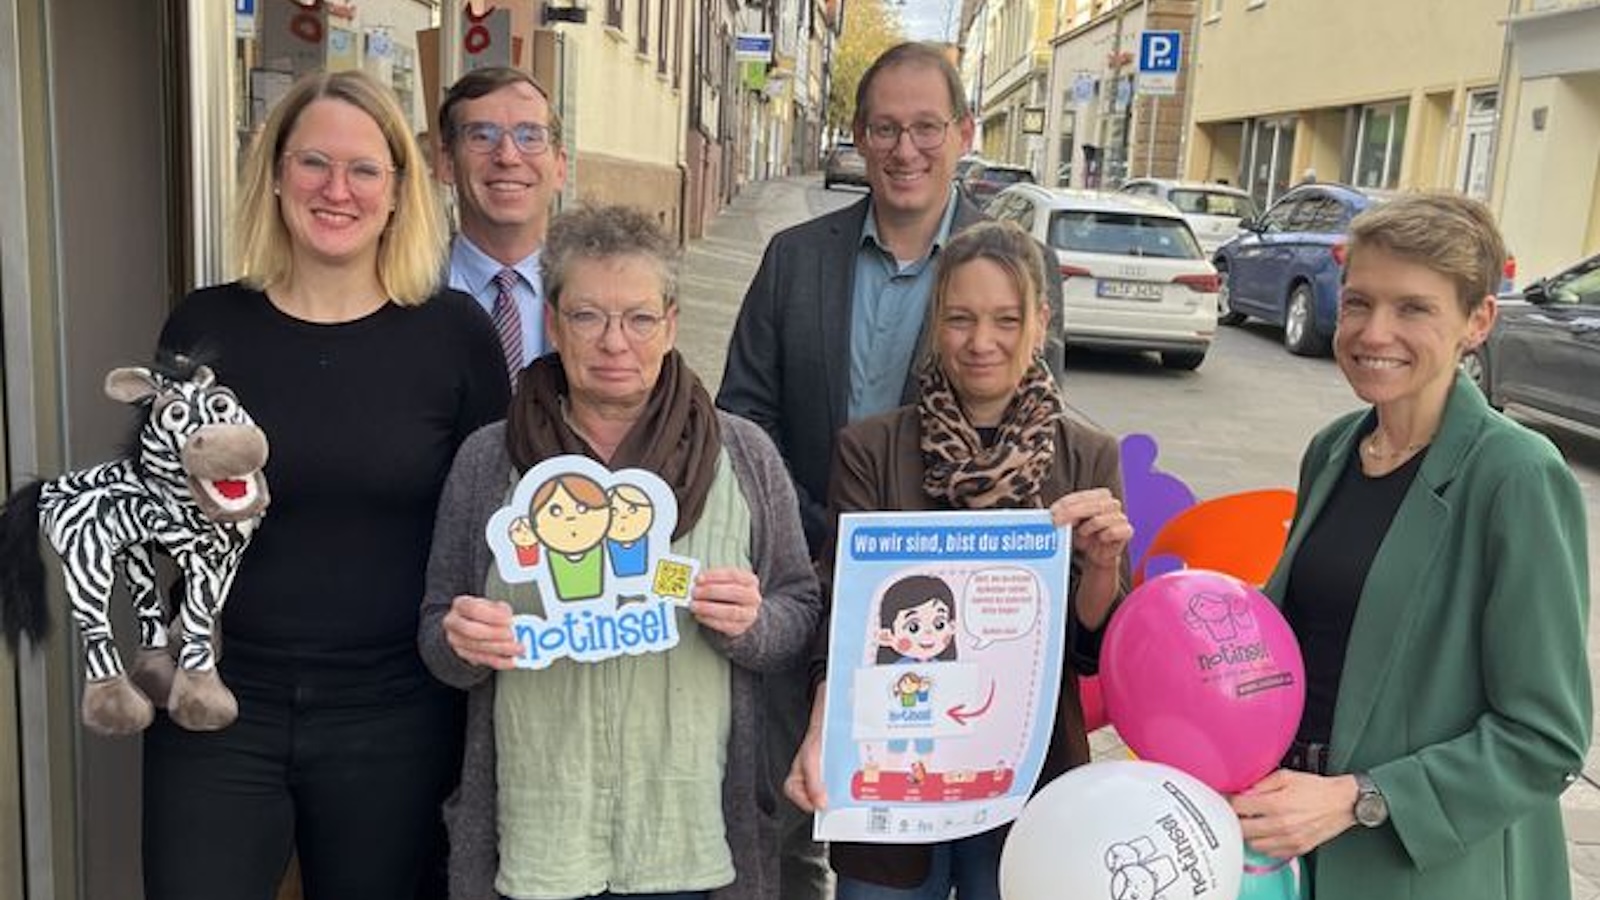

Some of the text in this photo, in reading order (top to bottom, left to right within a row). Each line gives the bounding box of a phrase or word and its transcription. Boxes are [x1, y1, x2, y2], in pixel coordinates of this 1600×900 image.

[1148, 36, 1171, 69] P
[854, 531, 1056, 554] Wo wir sind, bist du sicher!
[516, 601, 669, 660] notinsel
[1156, 813, 1208, 897] notinsel
